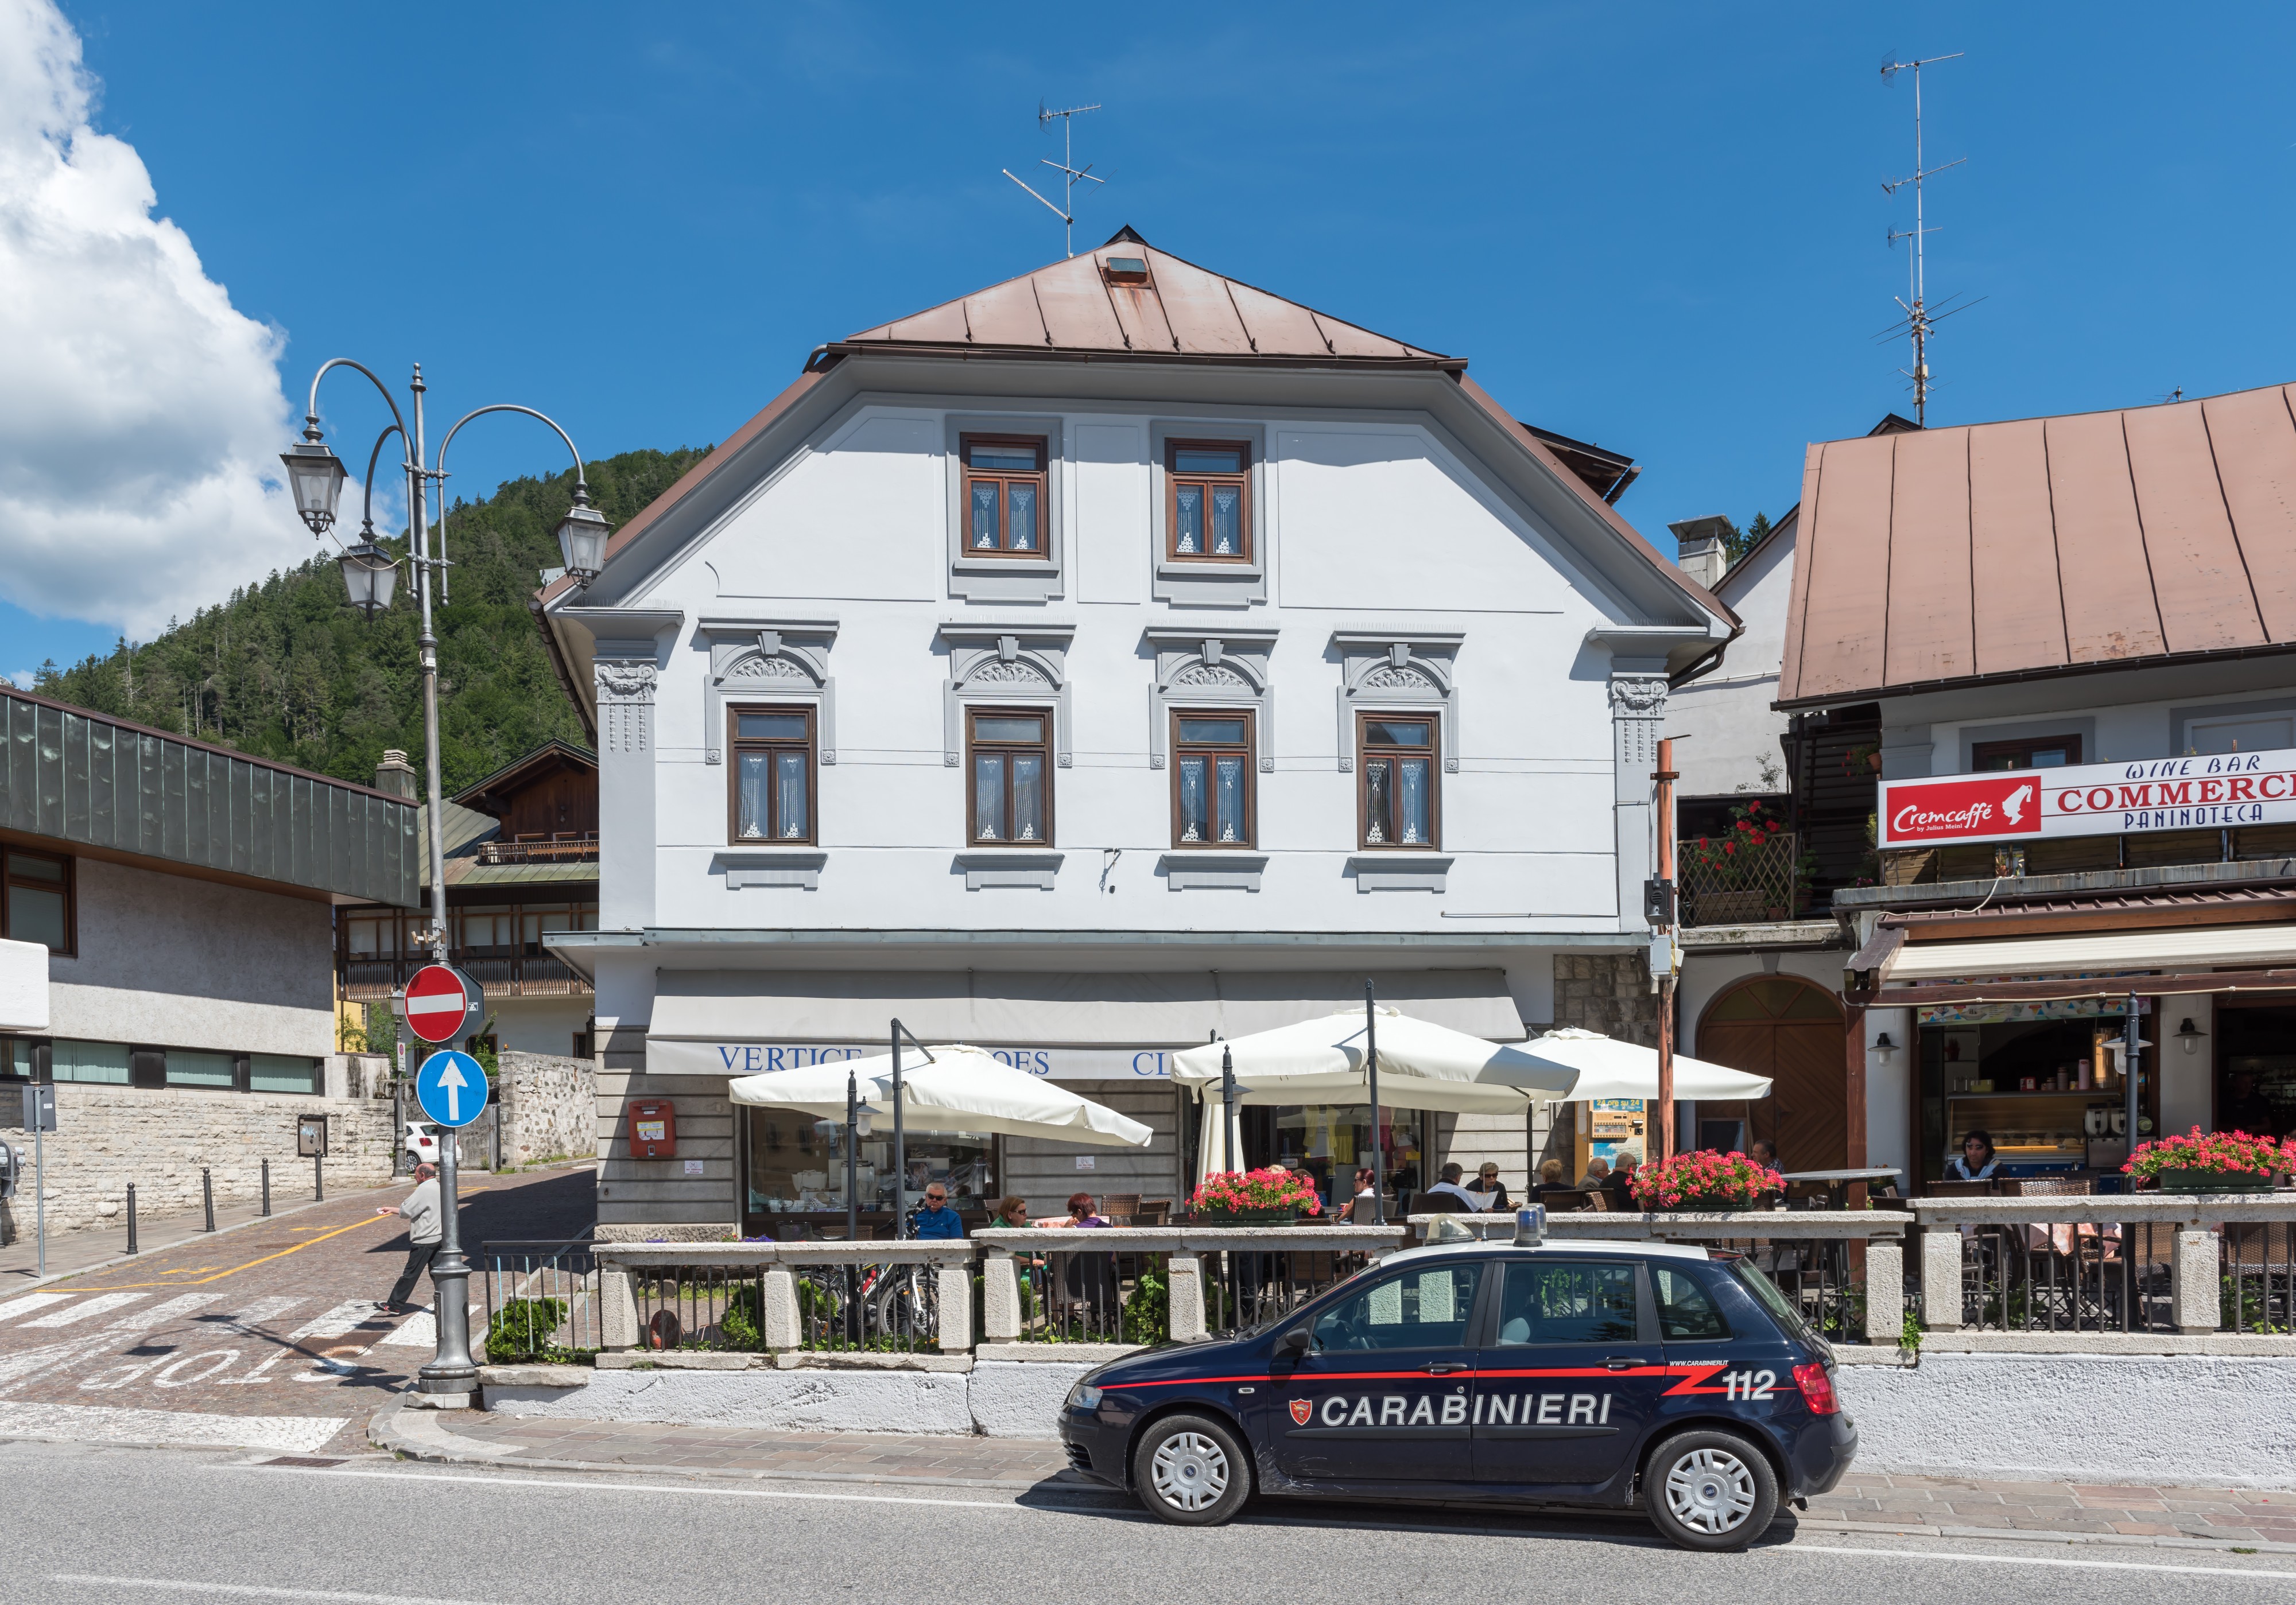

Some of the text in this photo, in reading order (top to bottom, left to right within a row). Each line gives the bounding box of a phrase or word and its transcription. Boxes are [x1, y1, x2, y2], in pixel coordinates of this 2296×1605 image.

[2126, 755, 2260, 779] WINE BAR
[1893, 802, 1993, 833] Cremcaffé
[2124, 803, 2262, 829] PANINOTECA
[1133, 1052, 1170, 1076] CL
[1723, 1370, 1776, 1400] 112
[1321, 1394, 1611, 1426] CARABINIERI
